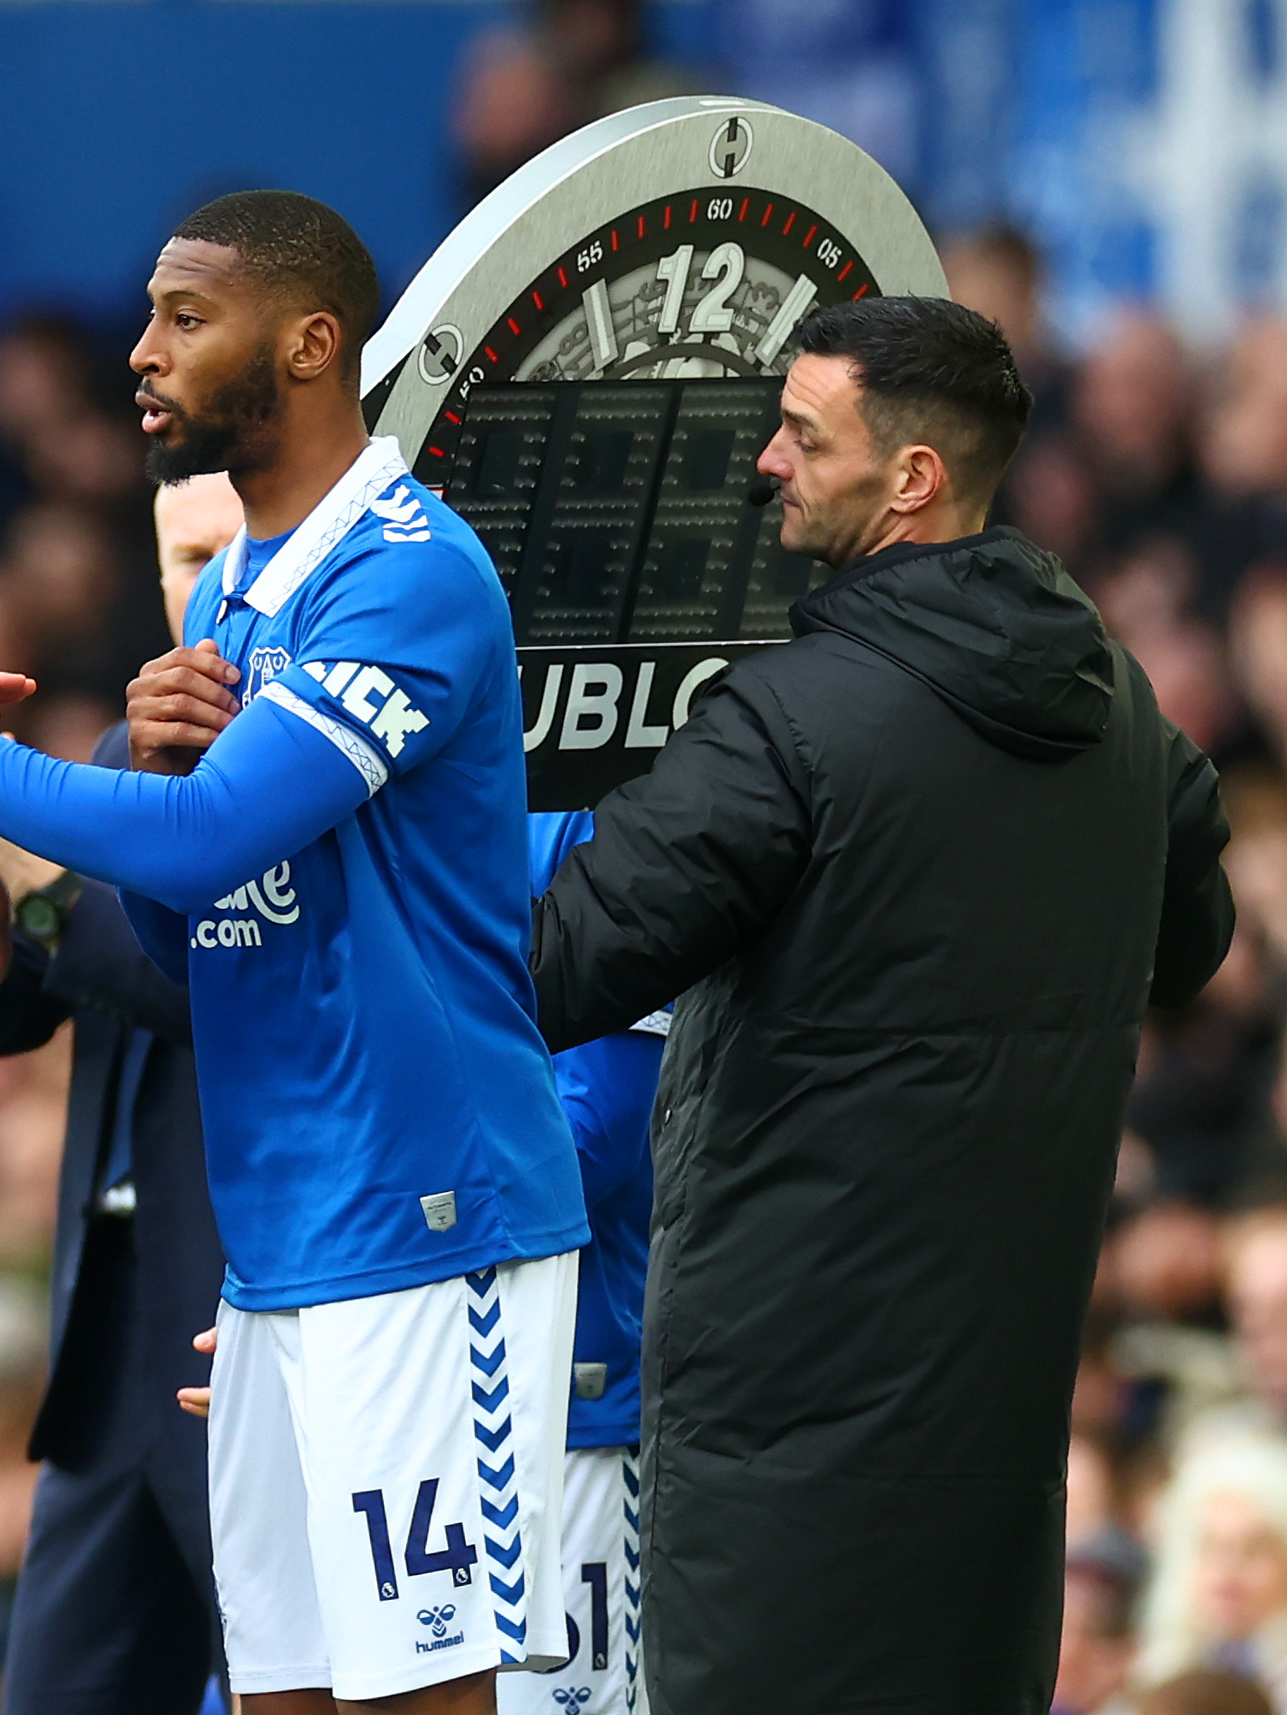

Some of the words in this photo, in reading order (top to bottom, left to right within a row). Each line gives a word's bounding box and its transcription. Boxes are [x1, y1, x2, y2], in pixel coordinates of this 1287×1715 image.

[707, 199, 733, 220] 60
[576, 240, 603, 273] 55
[817, 238, 842, 269] 05
[656, 242, 745, 333] 12
[190, 919, 263, 949] .com
[351, 1477, 478, 1602] 14
[529, 1562, 608, 1674] 1
[415, 1630, 464, 1654] hummel
